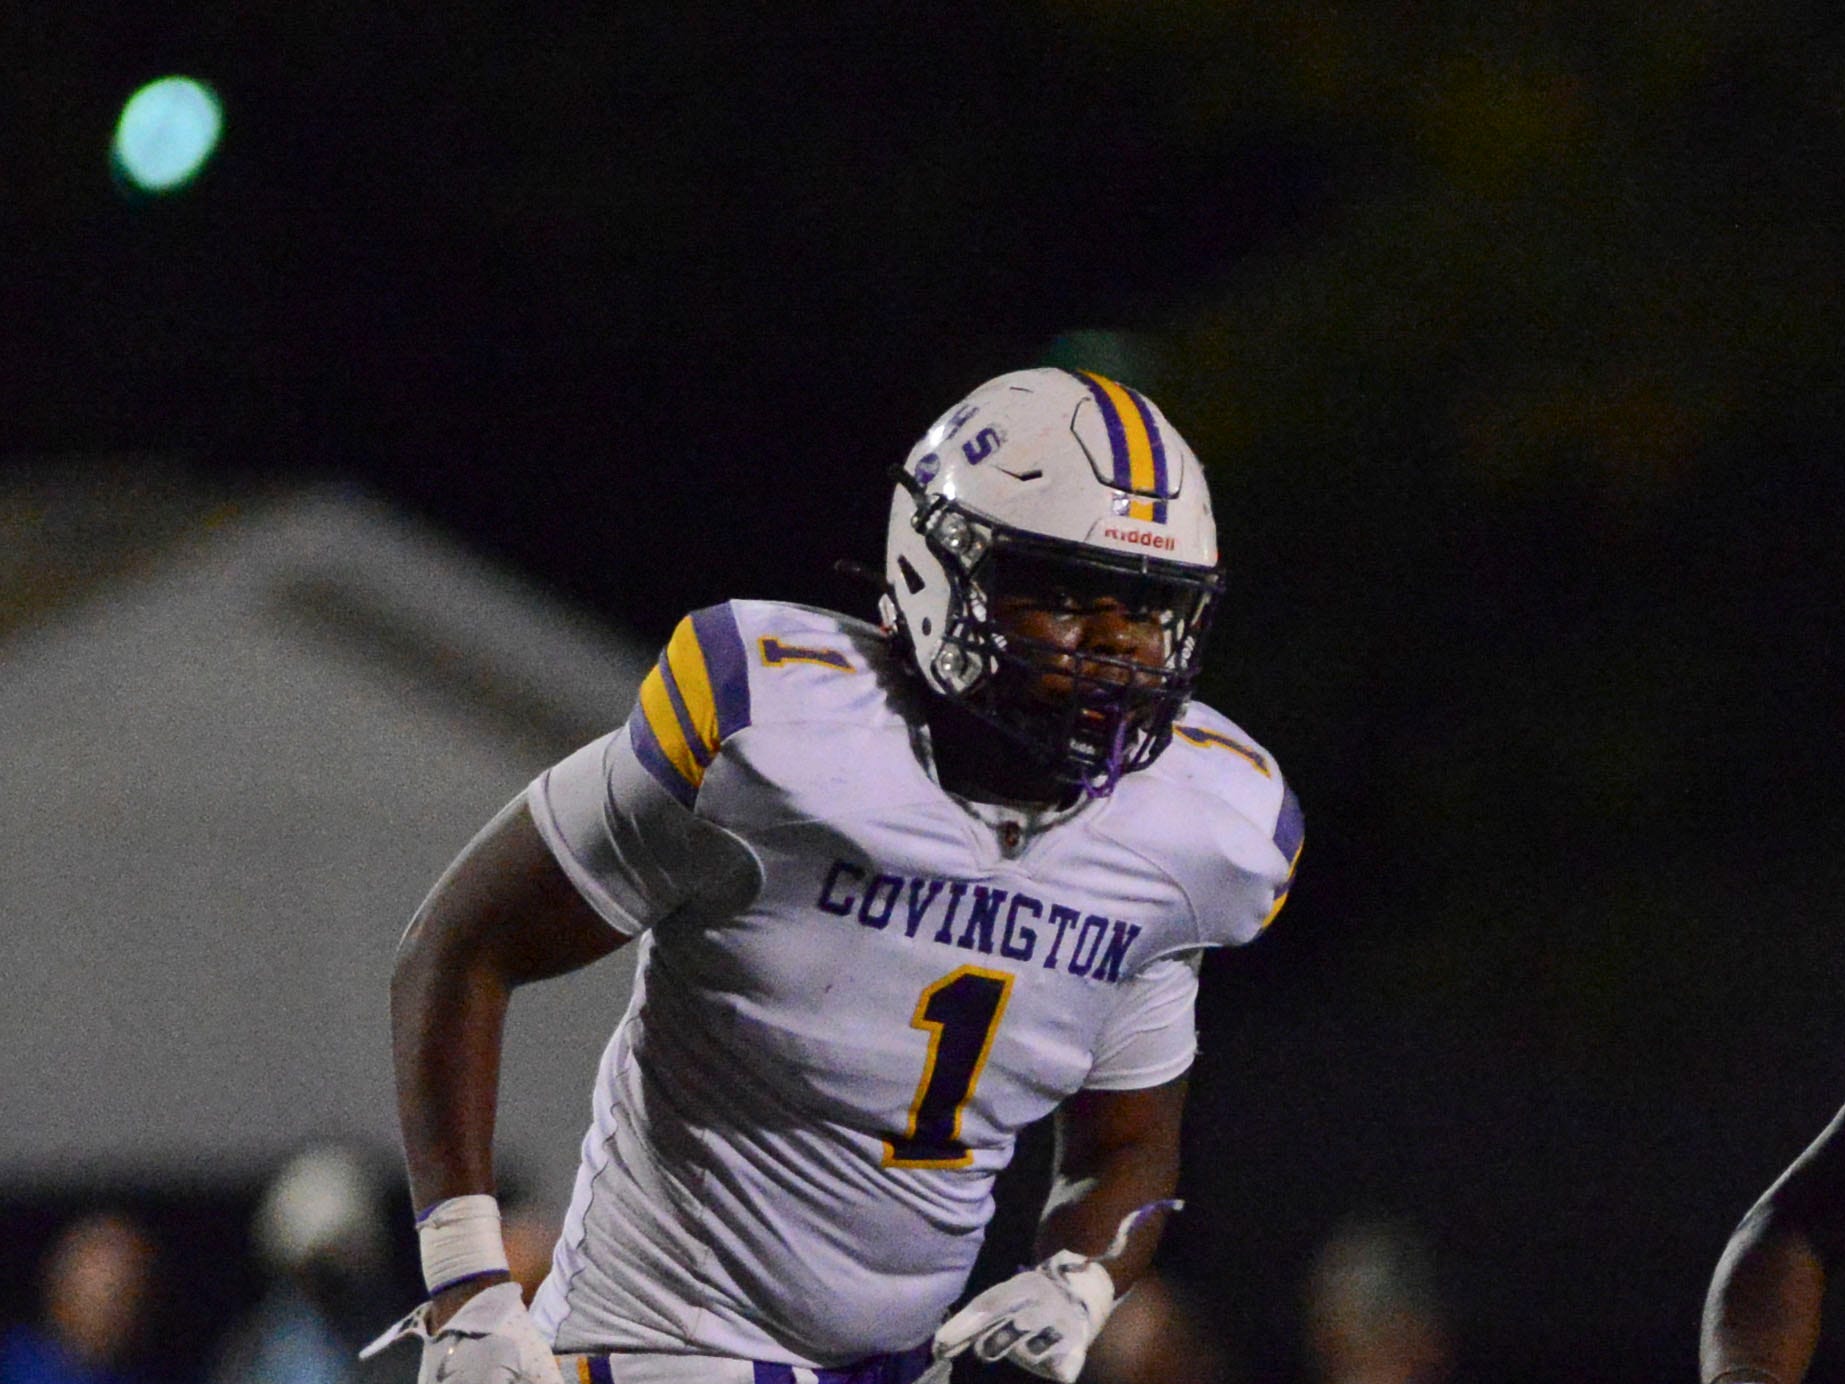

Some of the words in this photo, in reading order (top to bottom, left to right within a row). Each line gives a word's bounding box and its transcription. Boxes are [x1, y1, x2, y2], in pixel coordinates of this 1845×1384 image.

[758, 636, 857, 675] 1
[816, 860, 1142, 985] COVINGTON
[881, 964, 1016, 1170] 1
